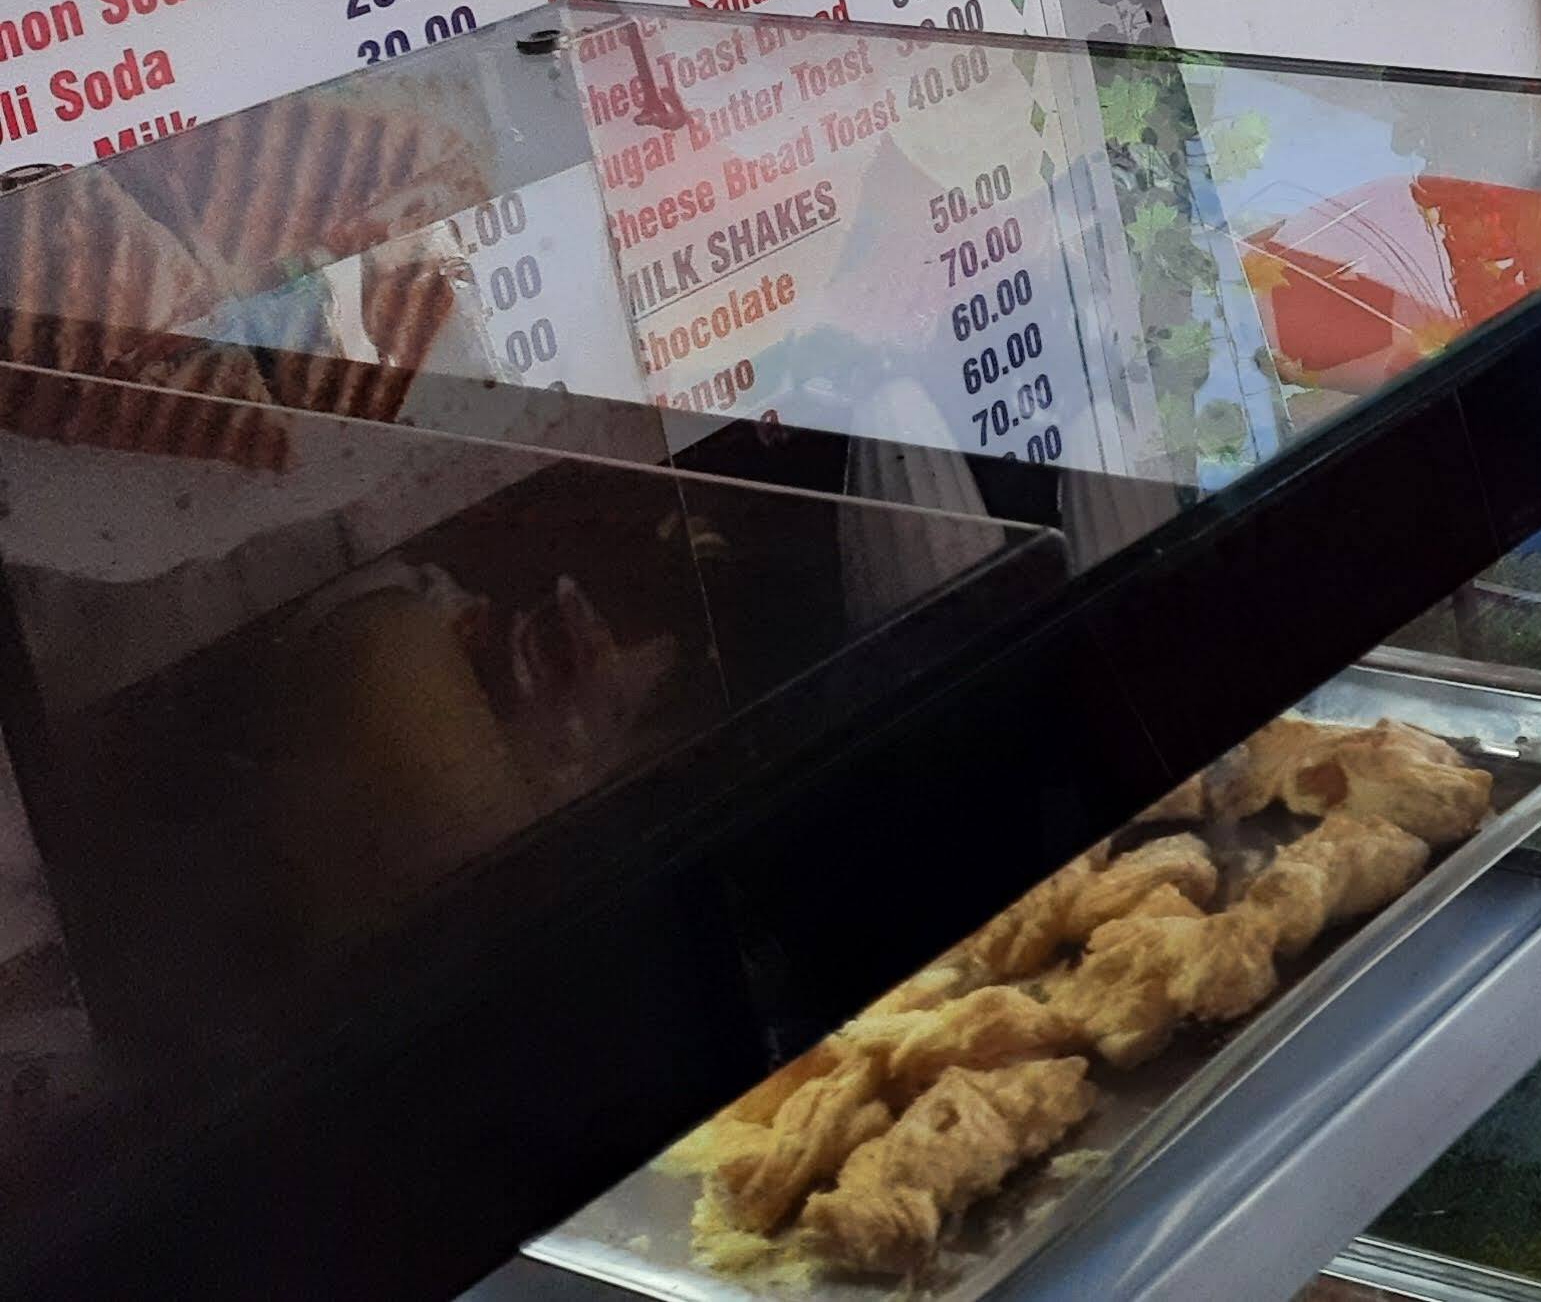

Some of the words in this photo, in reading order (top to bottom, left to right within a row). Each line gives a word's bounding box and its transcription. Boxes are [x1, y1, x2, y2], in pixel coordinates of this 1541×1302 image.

[50, 48, 175, 121] Soda
[656, 26, 748, 94] Toast
[602, 130, 676, 189] ugar
[790, 39, 873, 101] Toast
[722, 125, 816, 201] Bread
[820, 89, 900, 153] Toast
[908, 47, 989, 110] 40.00
[707, 180, 837, 274] SHAKES
[929, 164, 1012, 234] 50.00
[939, 217, 1023, 288] 70.00
[952, 269, 1033, 342] 60.00
[963, 322, 1043, 395] 60.00
[971, 374, 1053, 447] 70.00
